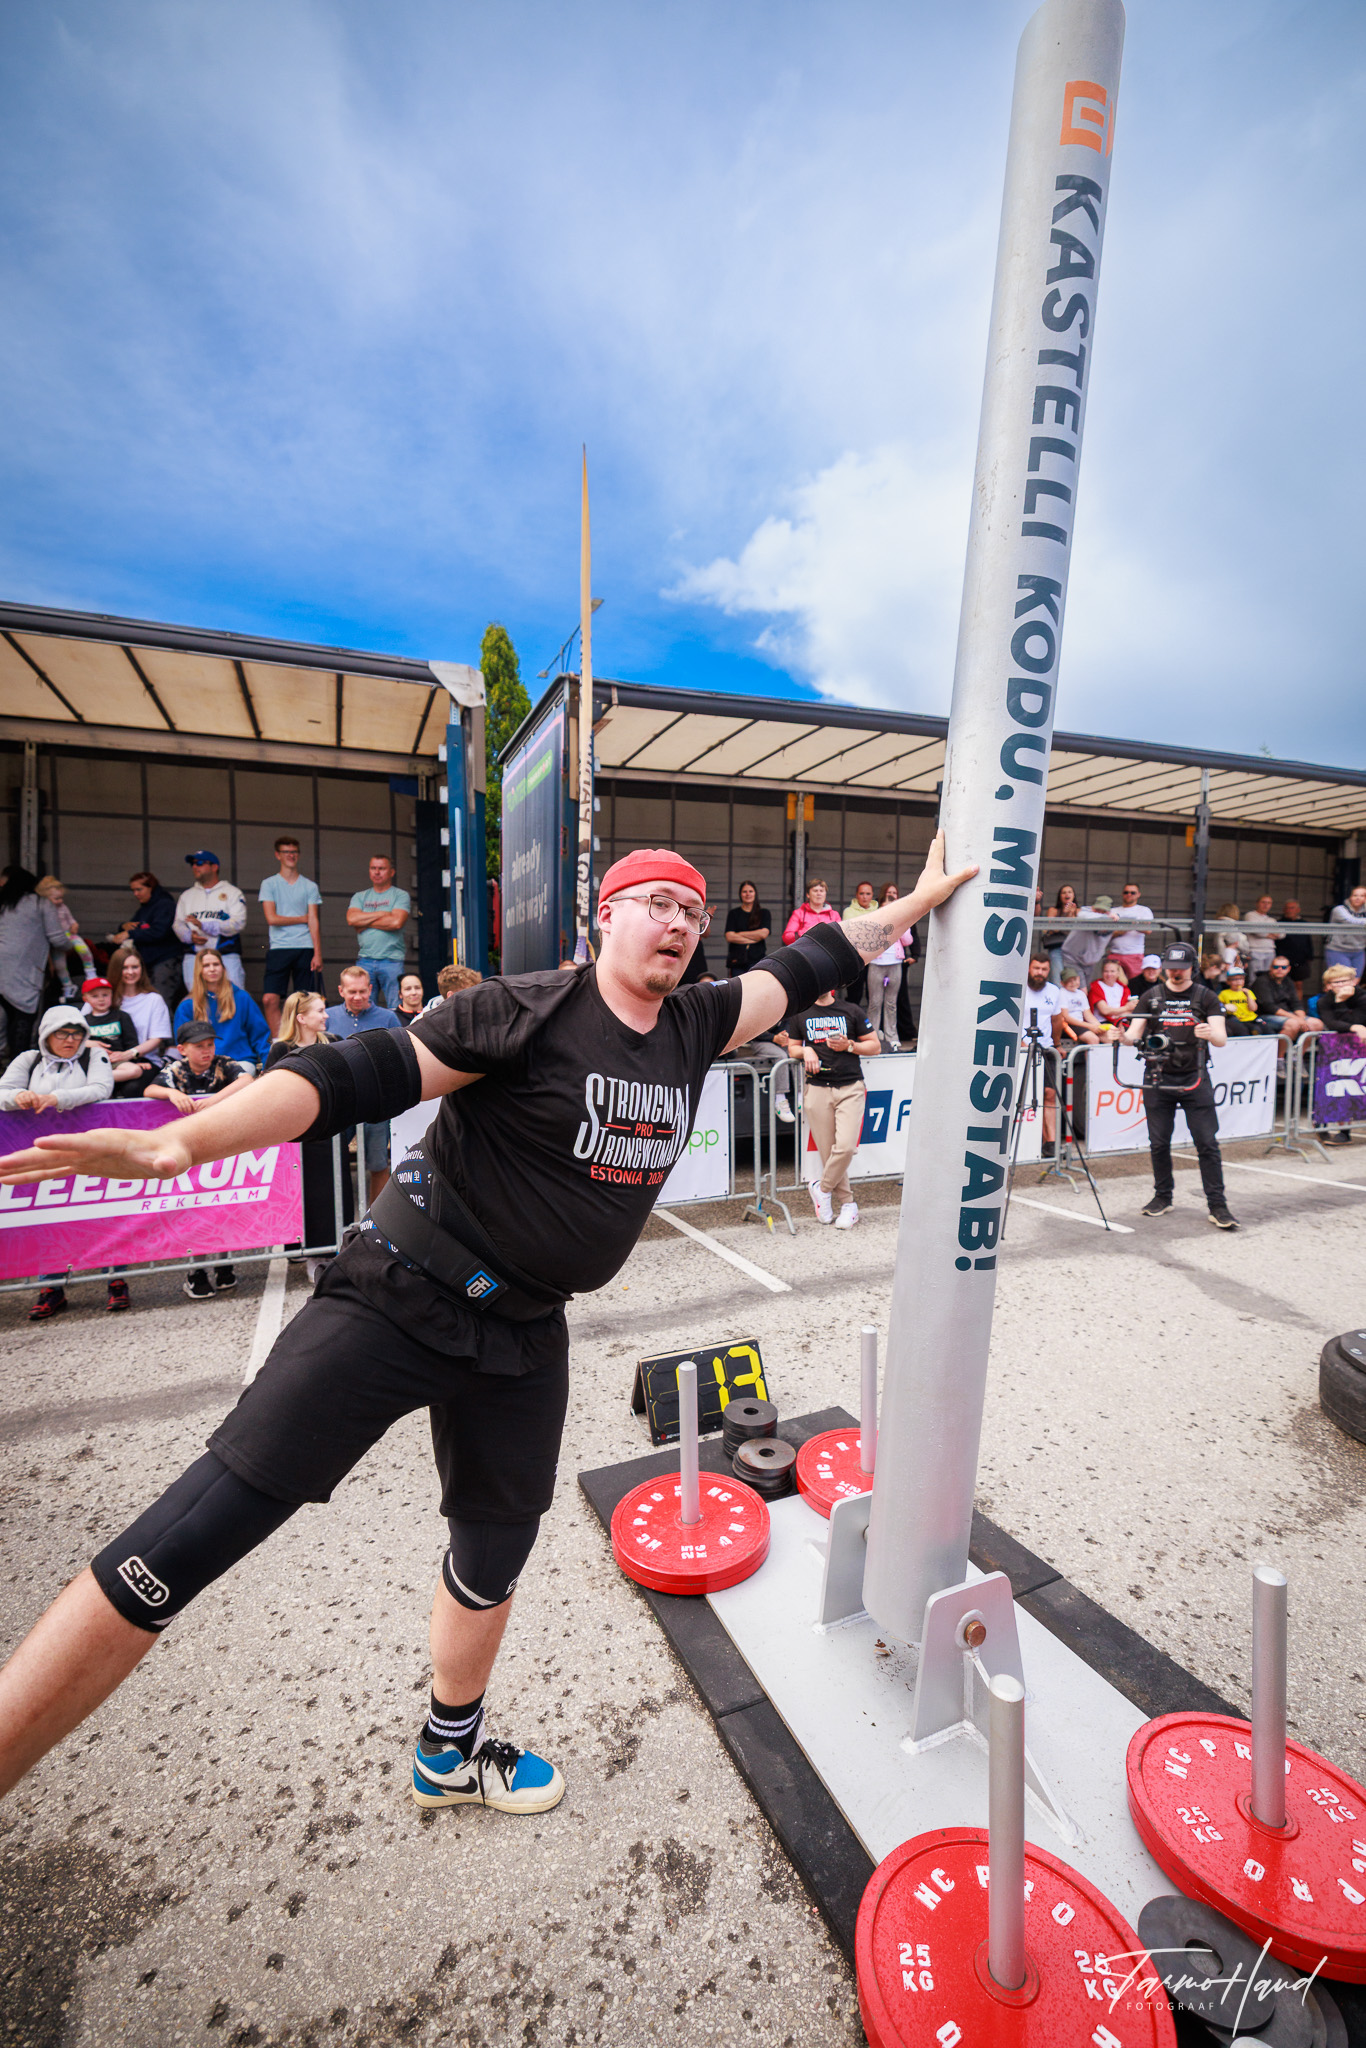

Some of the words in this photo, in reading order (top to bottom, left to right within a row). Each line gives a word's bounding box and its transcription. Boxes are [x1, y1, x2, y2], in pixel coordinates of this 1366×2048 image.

[1021, 174, 1102, 547] KASTELLI
[994, 574, 1063, 800] KODU,
[512, 838, 541, 883] already
[983, 826, 1037, 957] MIS
[506, 906, 515, 928] on
[526, 883, 547, 925] way!
[573, 1072, 690, 1142] STRONGMAN
[634, 1122, 653, 1137] PRO
[955, 980, 1020, 1272] KESTAB!
[590, 1165, 642, 1185] ESTONIA
[141, 1189, 259, 1211] REKLAAM
[707, 1487, 732, 1502] HC
[636, 1533, 662, 1552] HC
[681, 1545, 694, 1559] 25
[119, 1558, 168, 1605] SBD
[1164, 1747, 1192, 1780] HC
[1306, 1788, 1340, 1805] 25
[1176, 1807, 1210, 1825] 25
[1324, 1806, 1357, 1823] KG
[1191, 1826, 1224, 1843] KG
[914, 1868, 955, 1911] HC
[898, 1942, 932, 1967] 25
[902, 1971, 934, 1992] KG
[1084, 1978, 1121, 2001] KG
